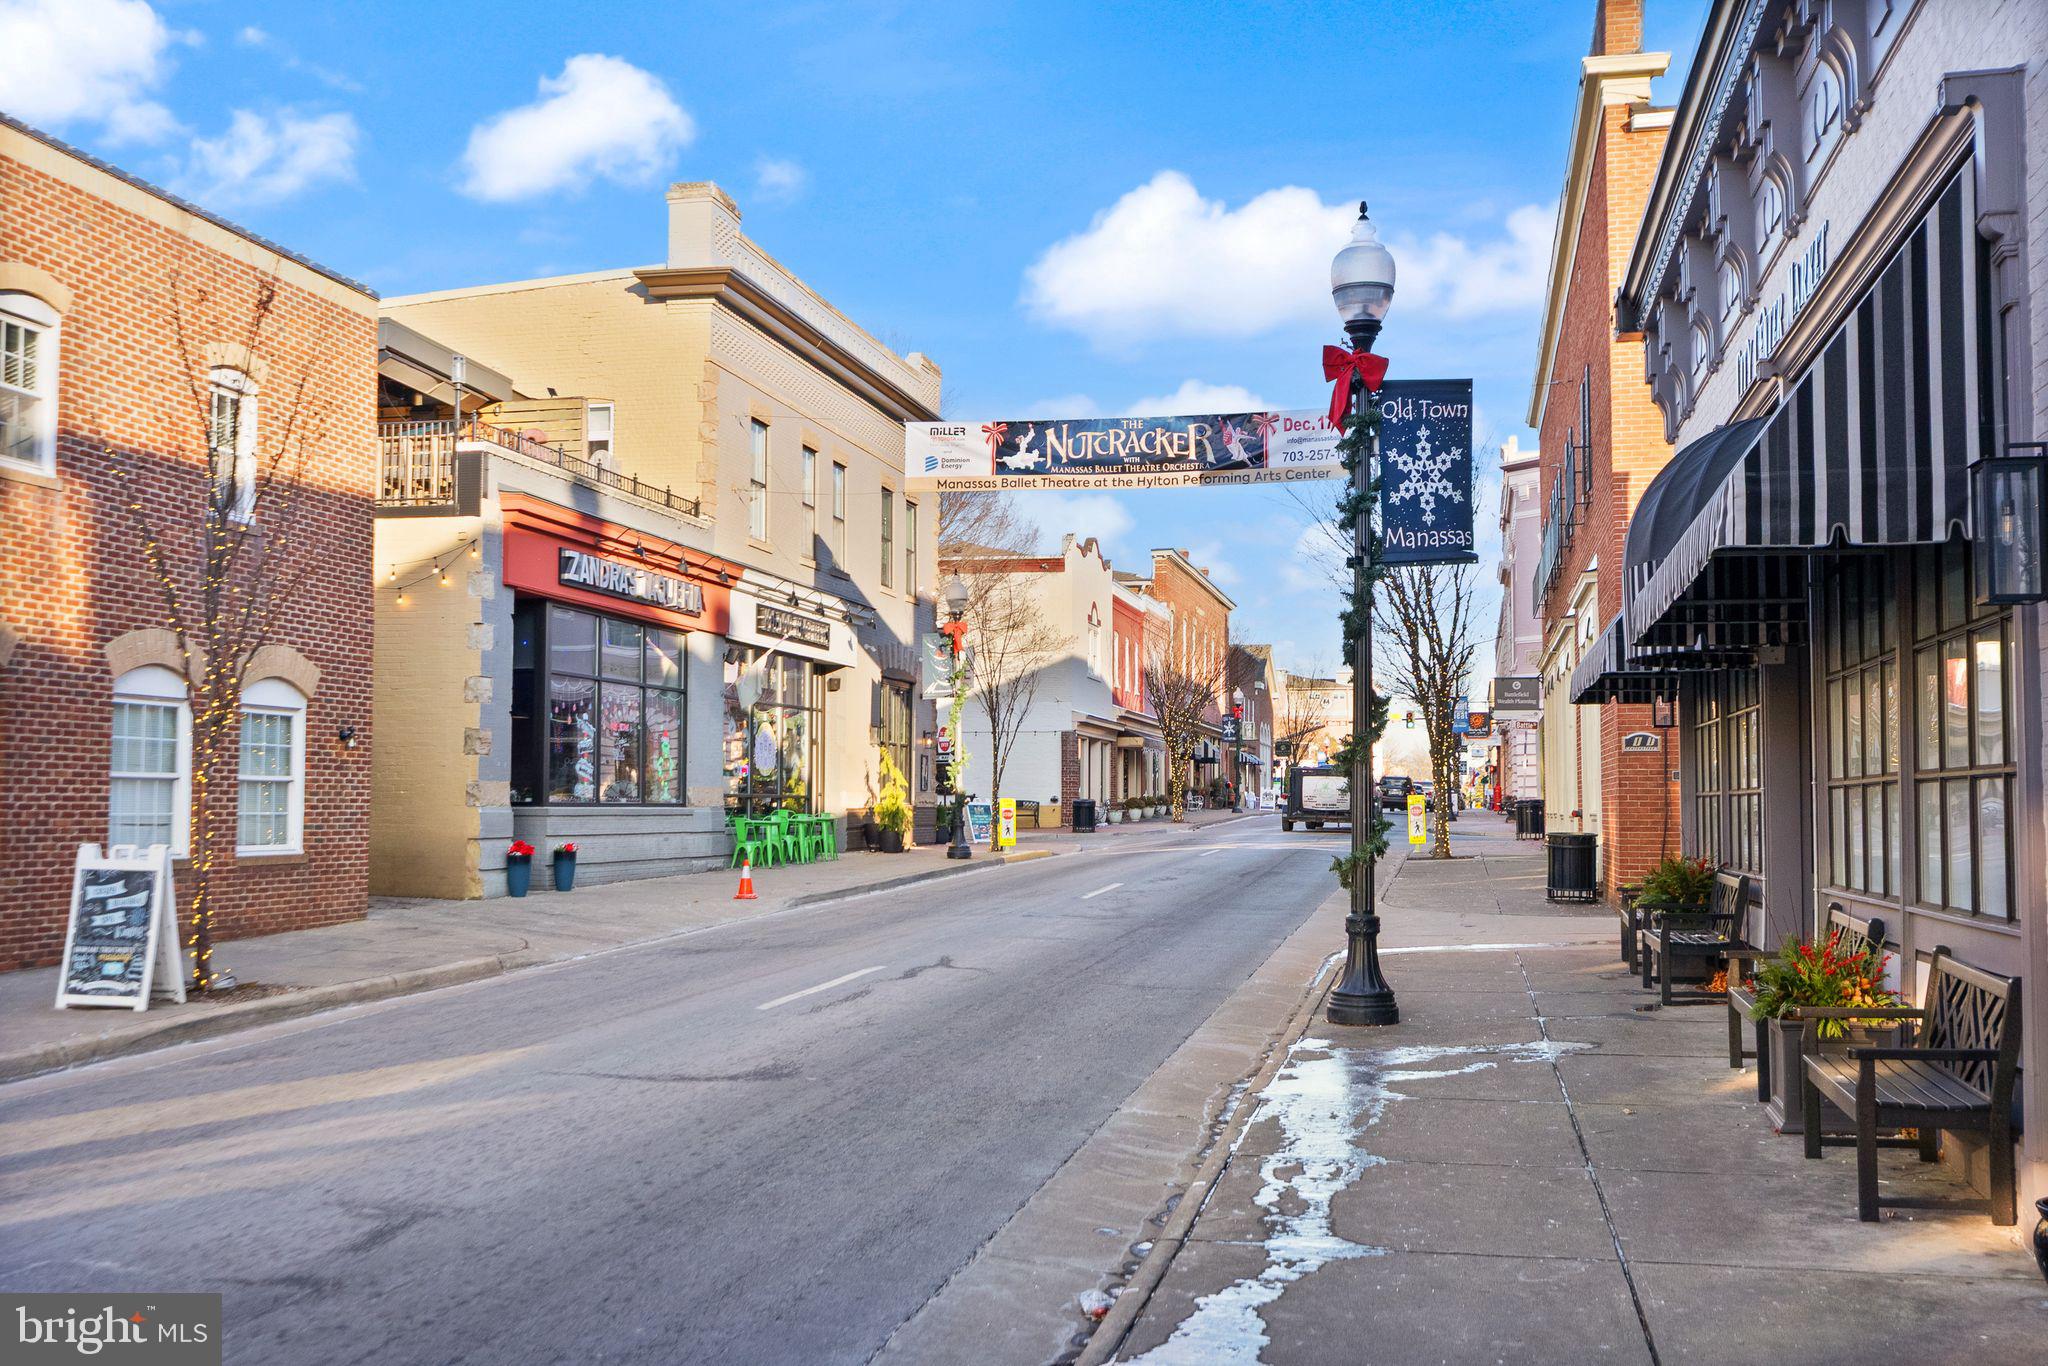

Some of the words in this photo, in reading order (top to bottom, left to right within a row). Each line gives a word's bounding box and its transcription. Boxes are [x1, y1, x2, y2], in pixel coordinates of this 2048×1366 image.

[1381, 397, 1413, 420] Old
[1419, 399, 1469, 419] Town
[1121, 420, 1143, 429] THE
[1283, 417, 1316, 432] Dec.
[1045, 423, 1216, 469] NUTCRACKER
[937, 479, 998, 490] Manassas
[1001, 478, 1037, 488] Ballet
[1041, 476, 1090, 488] Theatre
[1093, 477, 1108, 487] at
[1111, 476, 1133, 487] the
[1136, 475, 1179, 489] Hylton
[1254, 470, 1281, 482] Arts
[1285, 468, 1332, 480] Center
[1050, 465, 1093, 474] MANASSAS
[1095, 464, 1122, 473] BALLET
[1124, 463, 1160, 473] THEATRE
[1162, 462, 1210, 472] ORCHESTRA
[1385, 526, 1473, 549] Manassas
